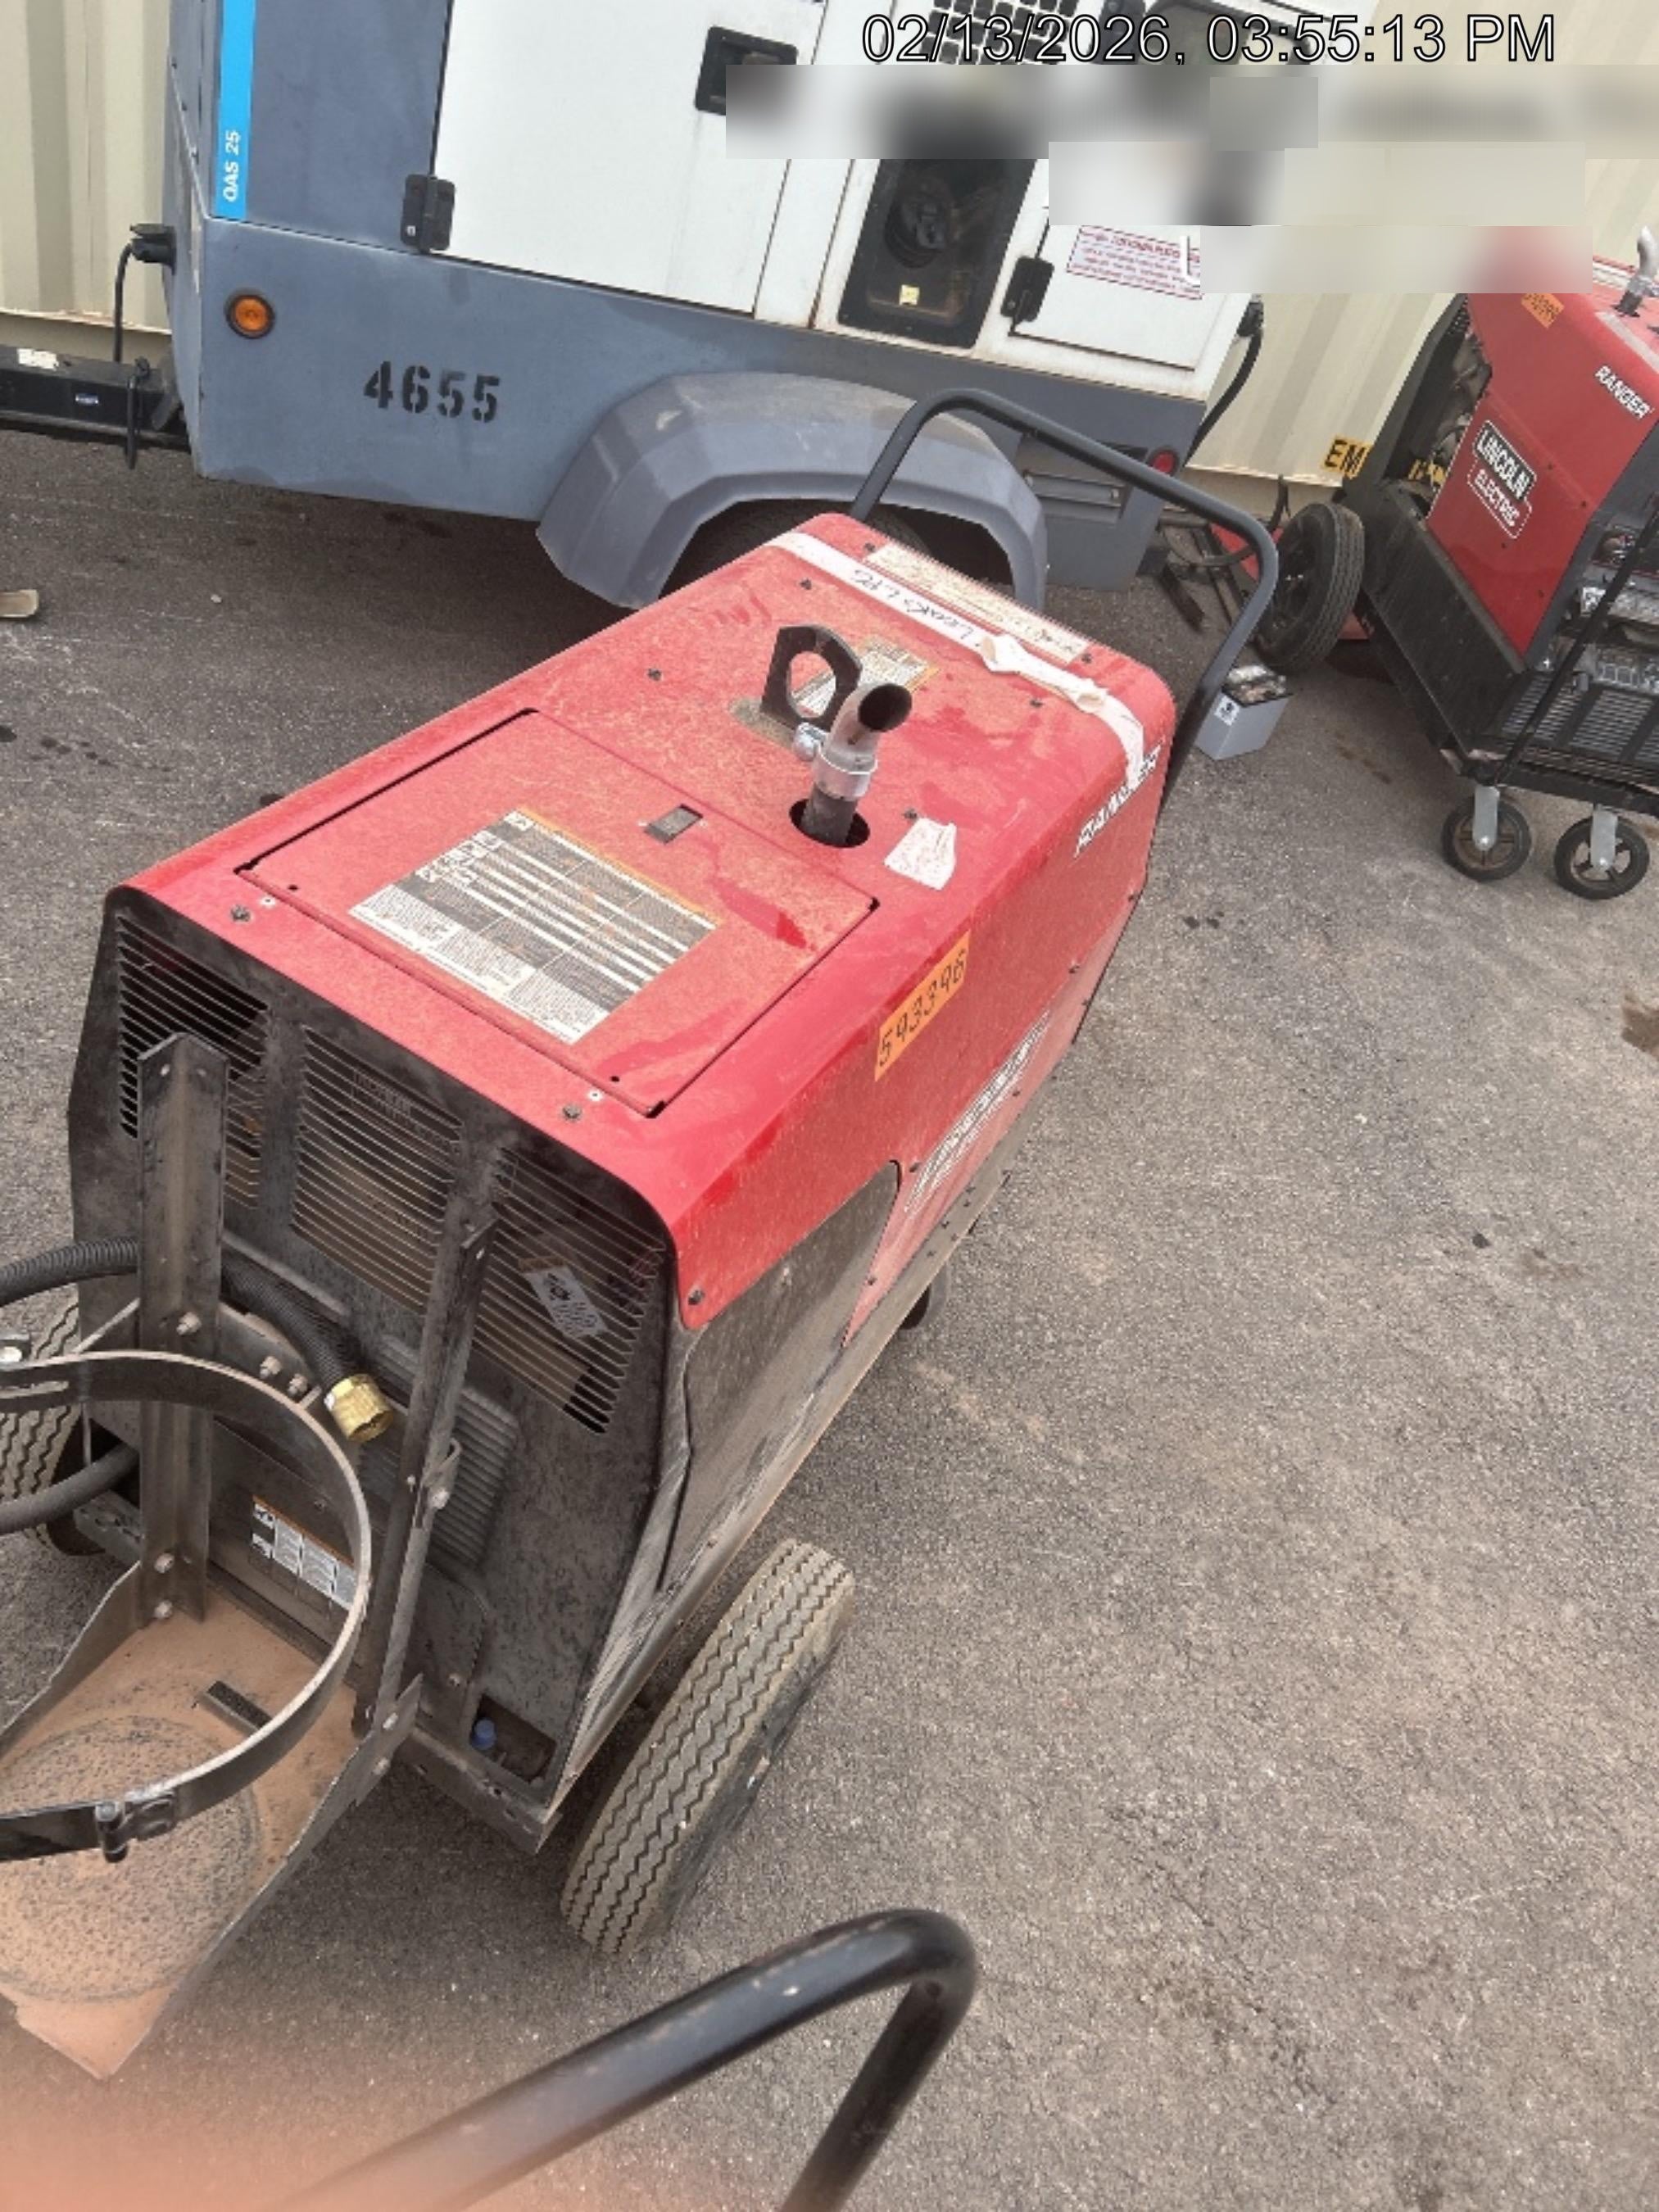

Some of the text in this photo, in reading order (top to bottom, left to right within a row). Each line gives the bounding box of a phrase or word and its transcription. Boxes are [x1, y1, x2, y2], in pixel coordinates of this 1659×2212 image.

[223, 129, 241, 202] QAS 25
[364, 360, 501, 423] 4655
[1594, 365, 1652, 419] RANGER
[1476, 429, 1531, 499] LINCOLN
[1474, 469, 1521, 527] ELECTRIC
[879, 949, 967, 1067] 593396
